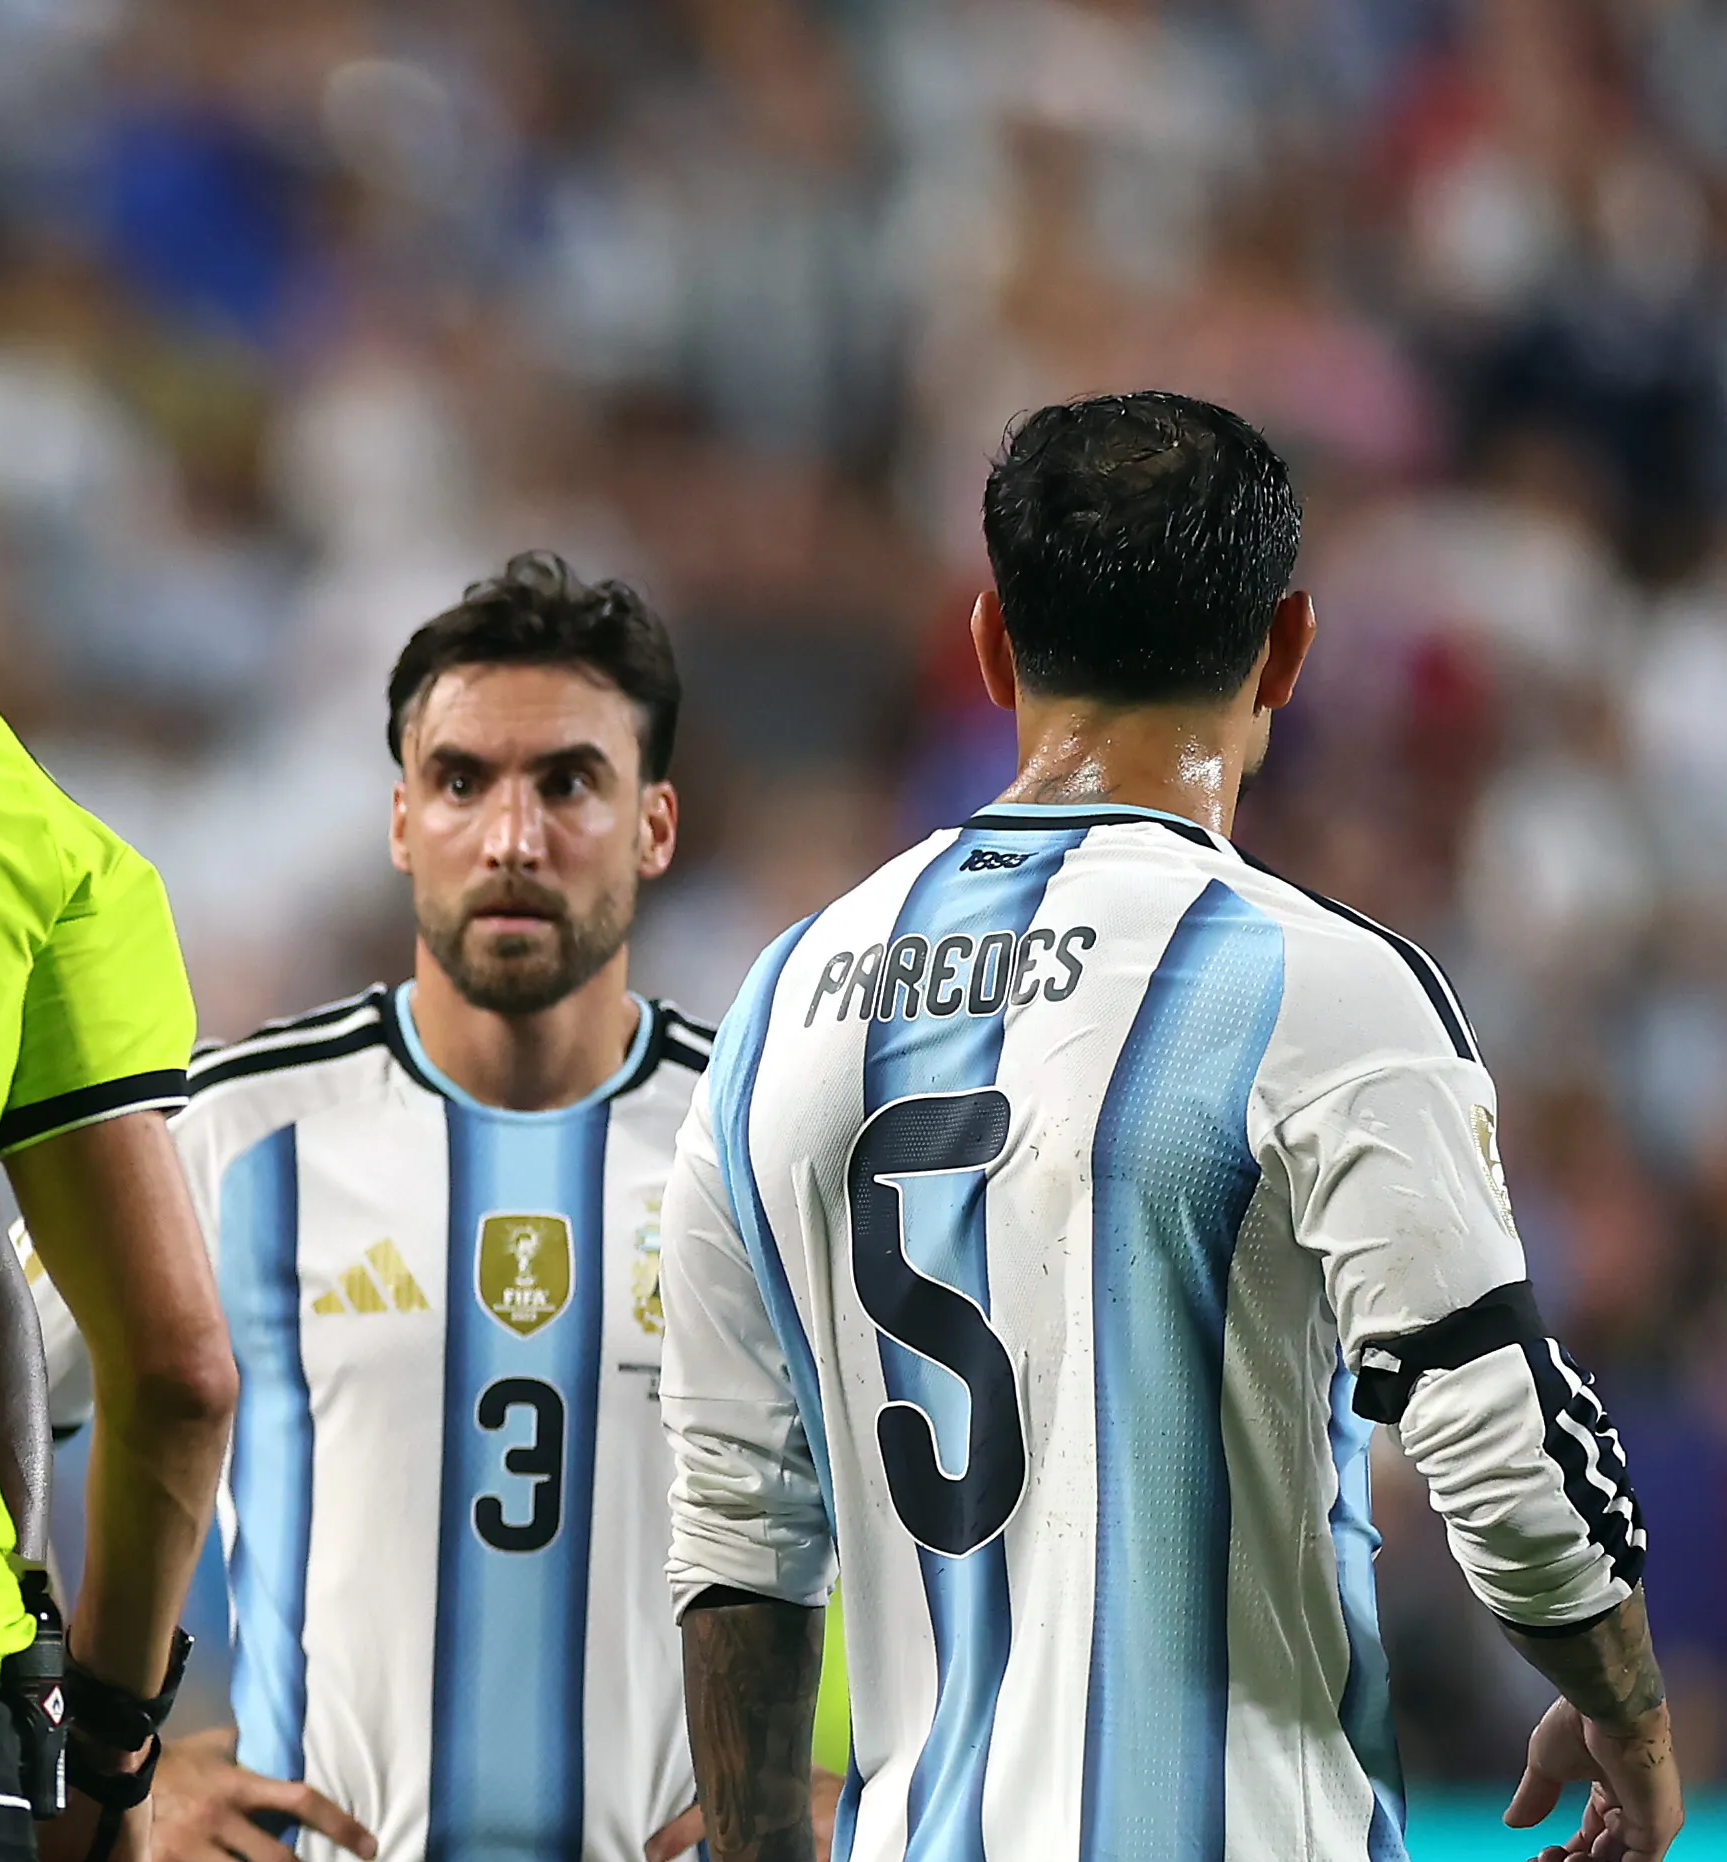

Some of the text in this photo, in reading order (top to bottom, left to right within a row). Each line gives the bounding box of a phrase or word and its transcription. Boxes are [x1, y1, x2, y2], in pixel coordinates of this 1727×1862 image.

[803, 924, 1098, 1029] PAREDES
[503, 1287, 548, 1306] FIFA
[846, 1084, 1030, 1559] 5
[470, 1375, 567, 1554] 3
